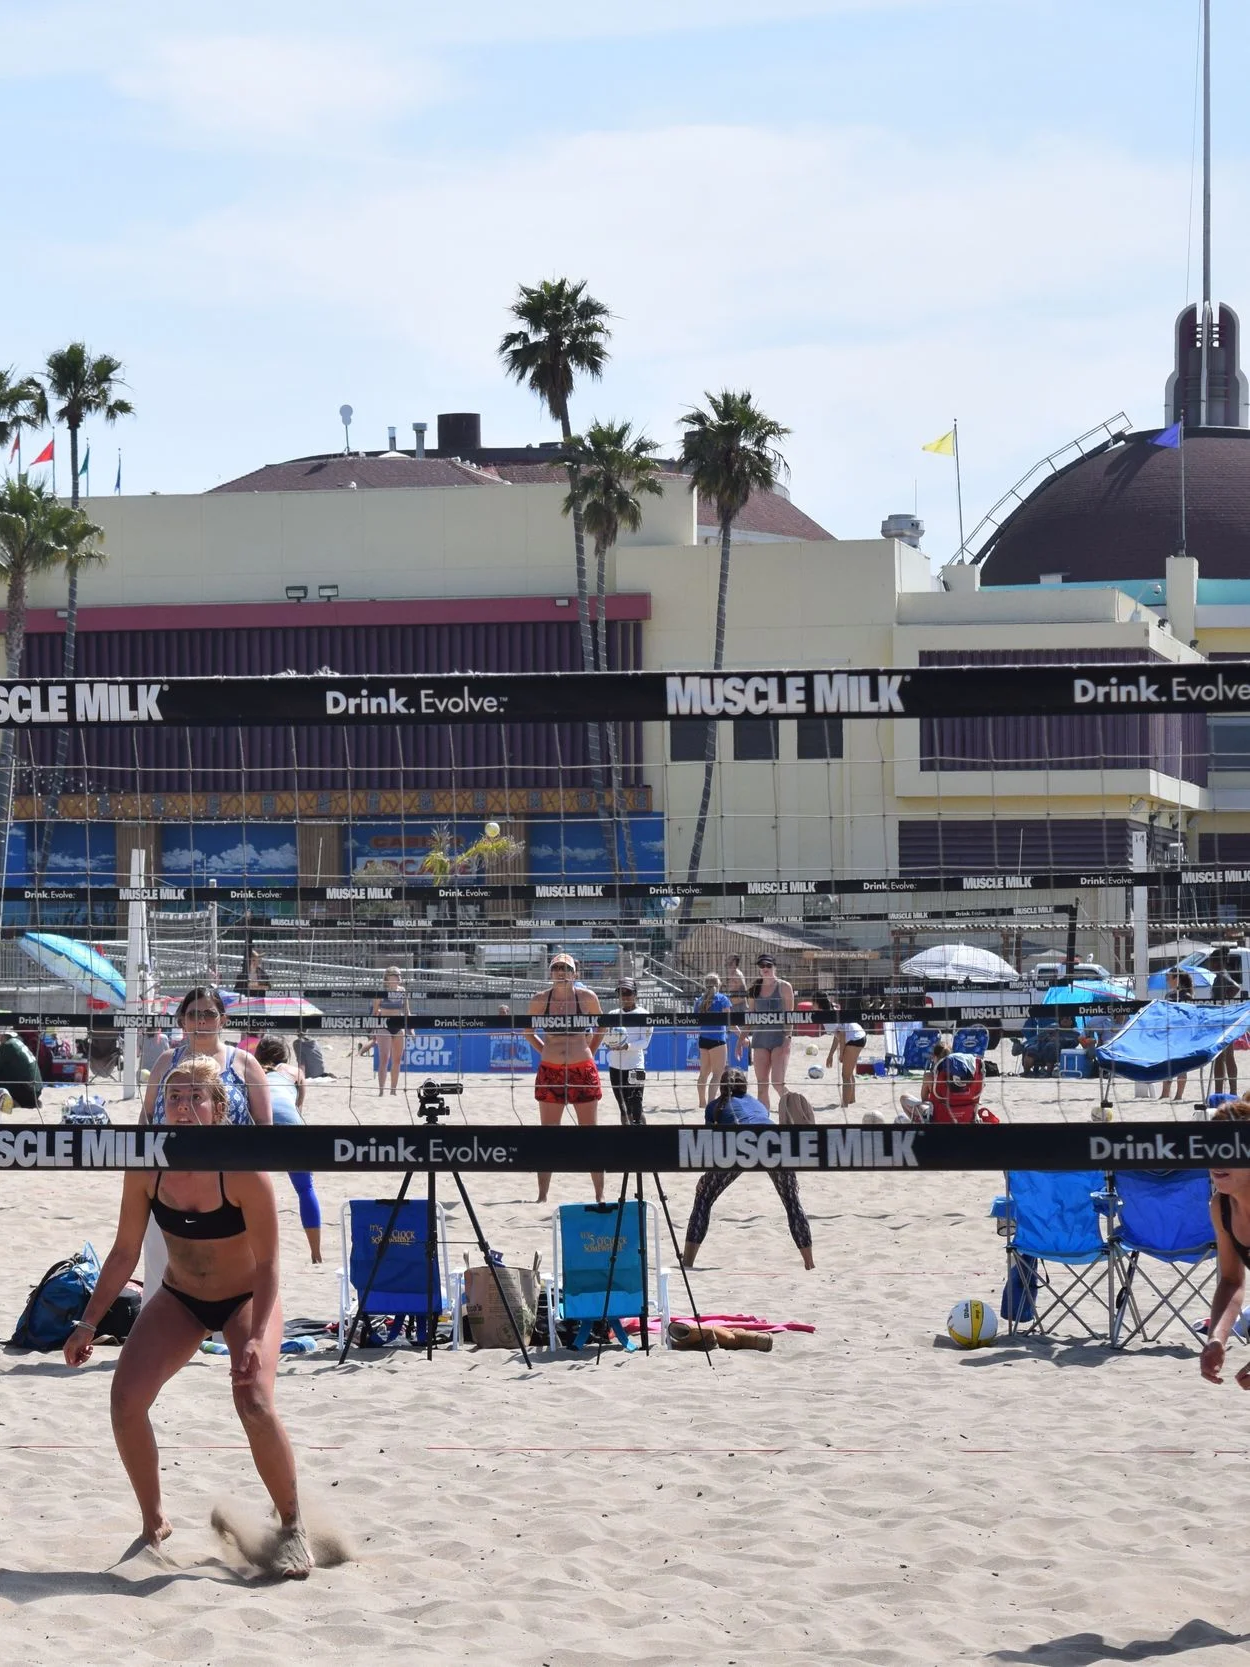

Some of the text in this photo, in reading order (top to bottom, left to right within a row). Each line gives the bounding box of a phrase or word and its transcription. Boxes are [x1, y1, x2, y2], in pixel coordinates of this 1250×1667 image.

[666, 675, 806, 716] MUSCLE
[1074, 676, 1167, 703] Drink.
[326, 688, 415, 715] Drink.
[963, 876, 1032, 889] MUSCLE MILK
[1080, 877, 1107, 885] Drink.
[1182, 870, 1250, 883] MUSCLE MILK
[536, 885, 603, 897] MUSCLE MILK
[650, 886, 676, 894] Drink.
[748, 881, 816, 894] MUSCLE MILK
[864, 882, 890, 890] Drink.
[25, 890, 50, 899] Drink.
[119, 889, 185, 900] MUSCLE MILK
[231, 890, 256, 898] Drink.
[326, 887, 392, 900] MUSCLE MILK
[439, 889, 465, 897] Drink.
[862, 1012, 888, 1021] Drink.
[961, 1006, 1030, 1019] MUSCLE MILK
[1079, 1006, 1106, 1015] Drink.
[19, 1016, 44, 1025] Drink.
[114, 1016, 152, 1027] MUSCLE
[226, 1019, 250, 1027] Drink.
[321, 1017, 388, 1029] MUSCLE MILK
[434, 1019, 460, 1027] Drink.
[532, 1016, 599, 1028] MUSCLE MILK
[646, 1016, 673, 1025] Drink.
[745, 1012, 813, 1024] MUSCLE MILK
[405, 1036, 444, 1051] BUD
[403, 1051, 452, 1066] IGHT
[334, 1137, 424, 1164] Drink.
[679, 1129, 820, 1169] MUSCLE
[1090, 1133, 1184, 1160] Drink.
